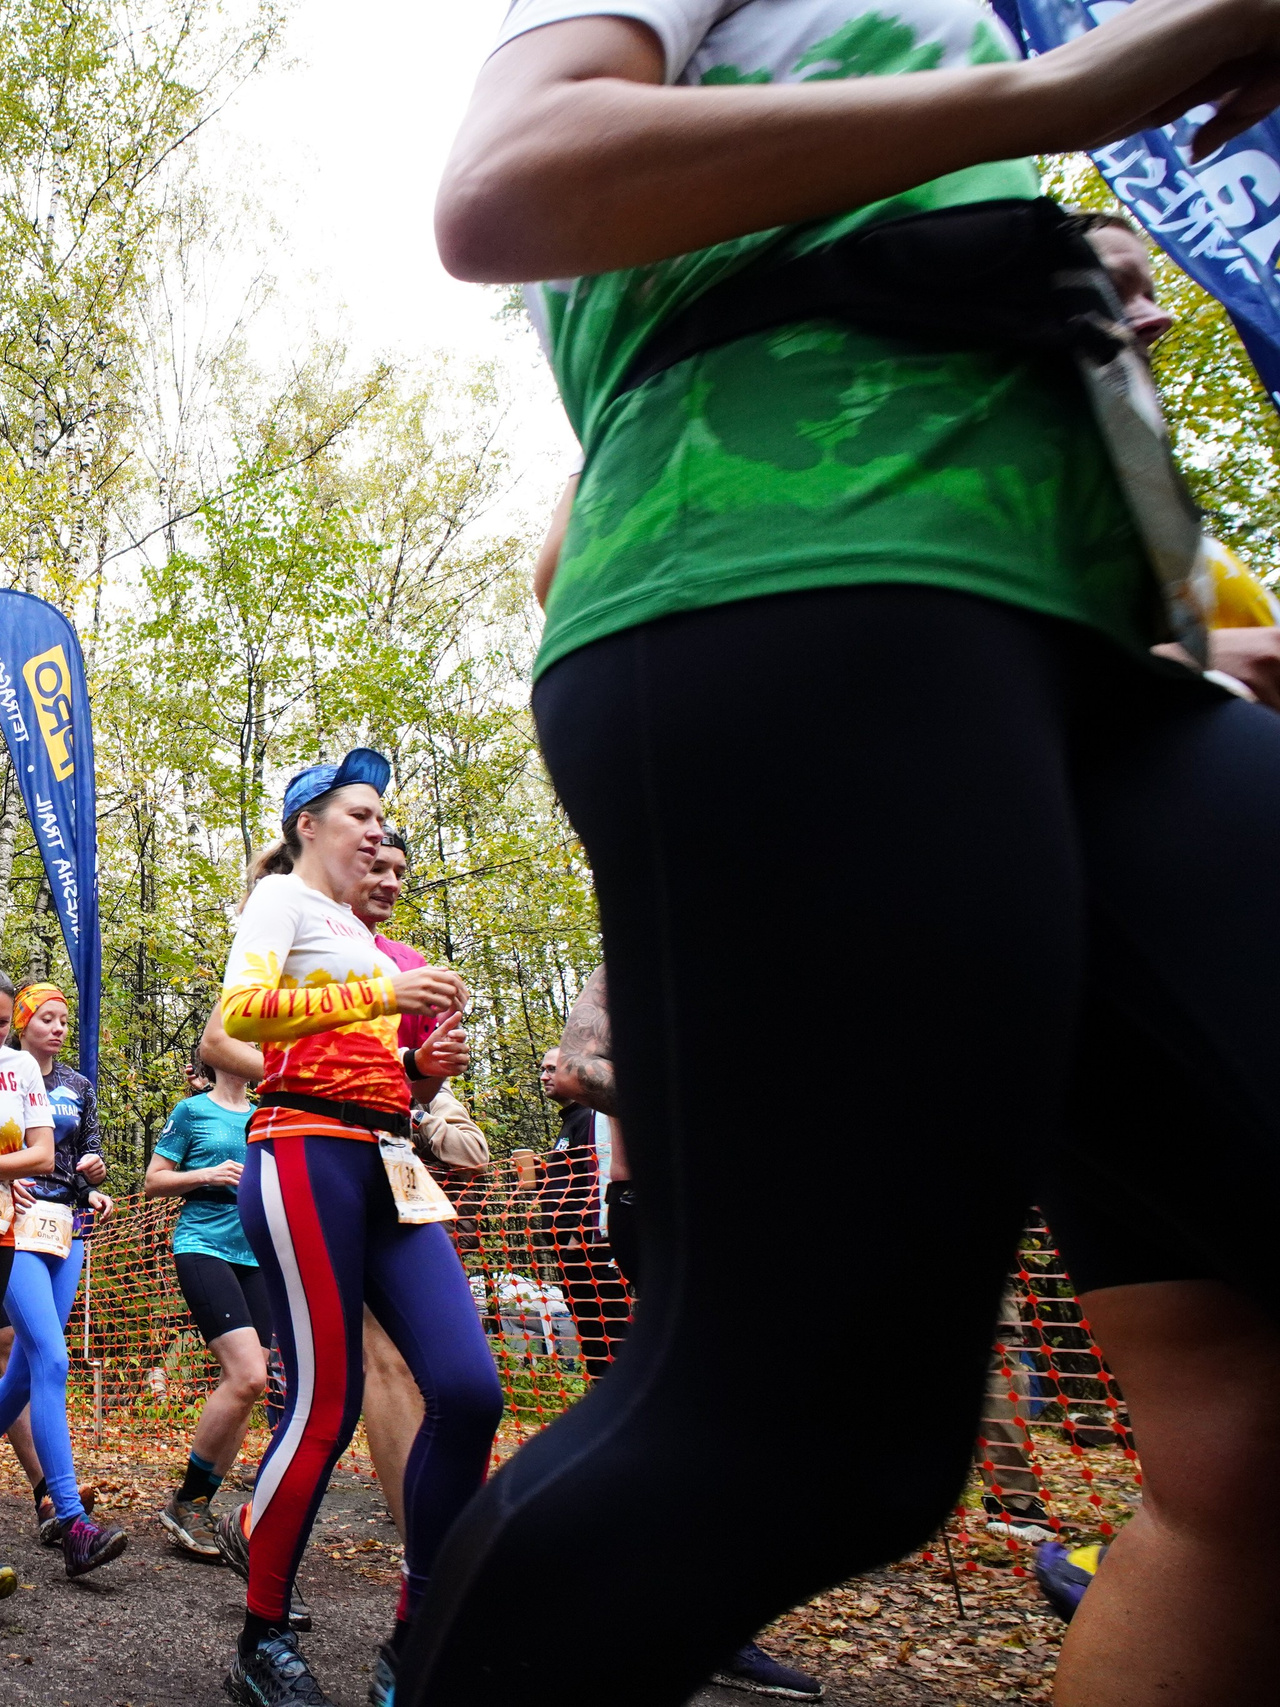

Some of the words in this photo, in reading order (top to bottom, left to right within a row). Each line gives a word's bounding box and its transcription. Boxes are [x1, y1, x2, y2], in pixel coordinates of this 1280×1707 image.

[232, 980, 374, 1019] ZMYLONG
[38, 1218, 58, 1233] 75
[37, 1230, 60, 1242] Ольга
